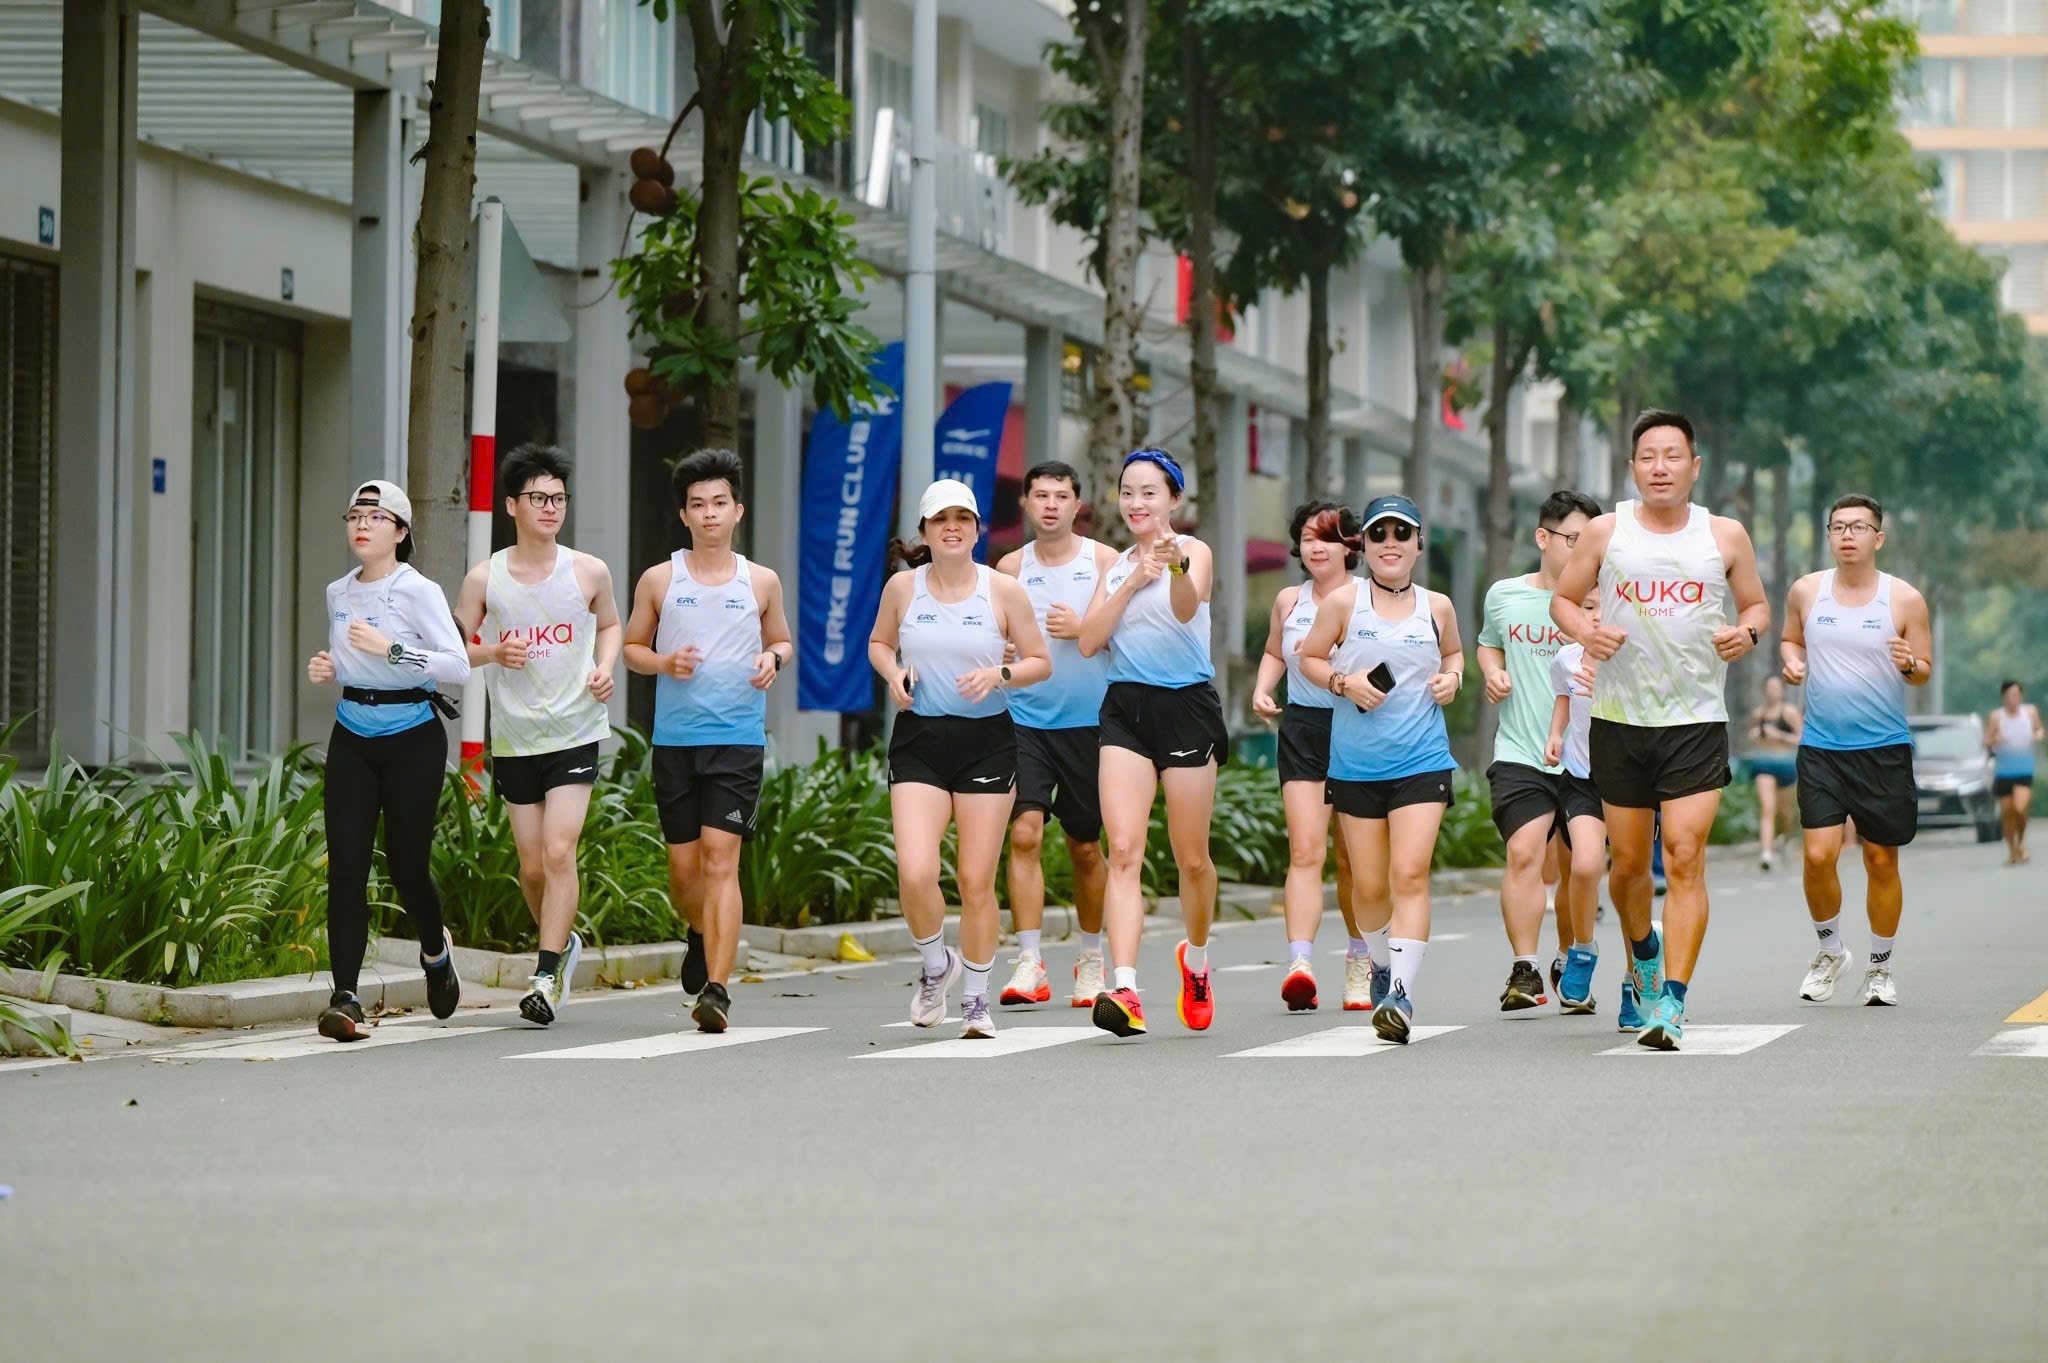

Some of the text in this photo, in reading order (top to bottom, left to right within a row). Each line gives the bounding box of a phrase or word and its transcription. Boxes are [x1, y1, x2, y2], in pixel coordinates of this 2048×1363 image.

[824, 421, 871, 665] ERKE RUN CLUB
[1639, 607, 1675, 617] HOME
[1818, 616, 1838, 624] ERC
[1358, 629, 1379, 638] ERC
[1508, 623, 1563, 646] KUK
[527, 649, 551, 659] OME
[1530, 648, 1558, 658] HOM
[725, 815, 743, 824] adidas
[1871, 949, 1892, 963] PUM
